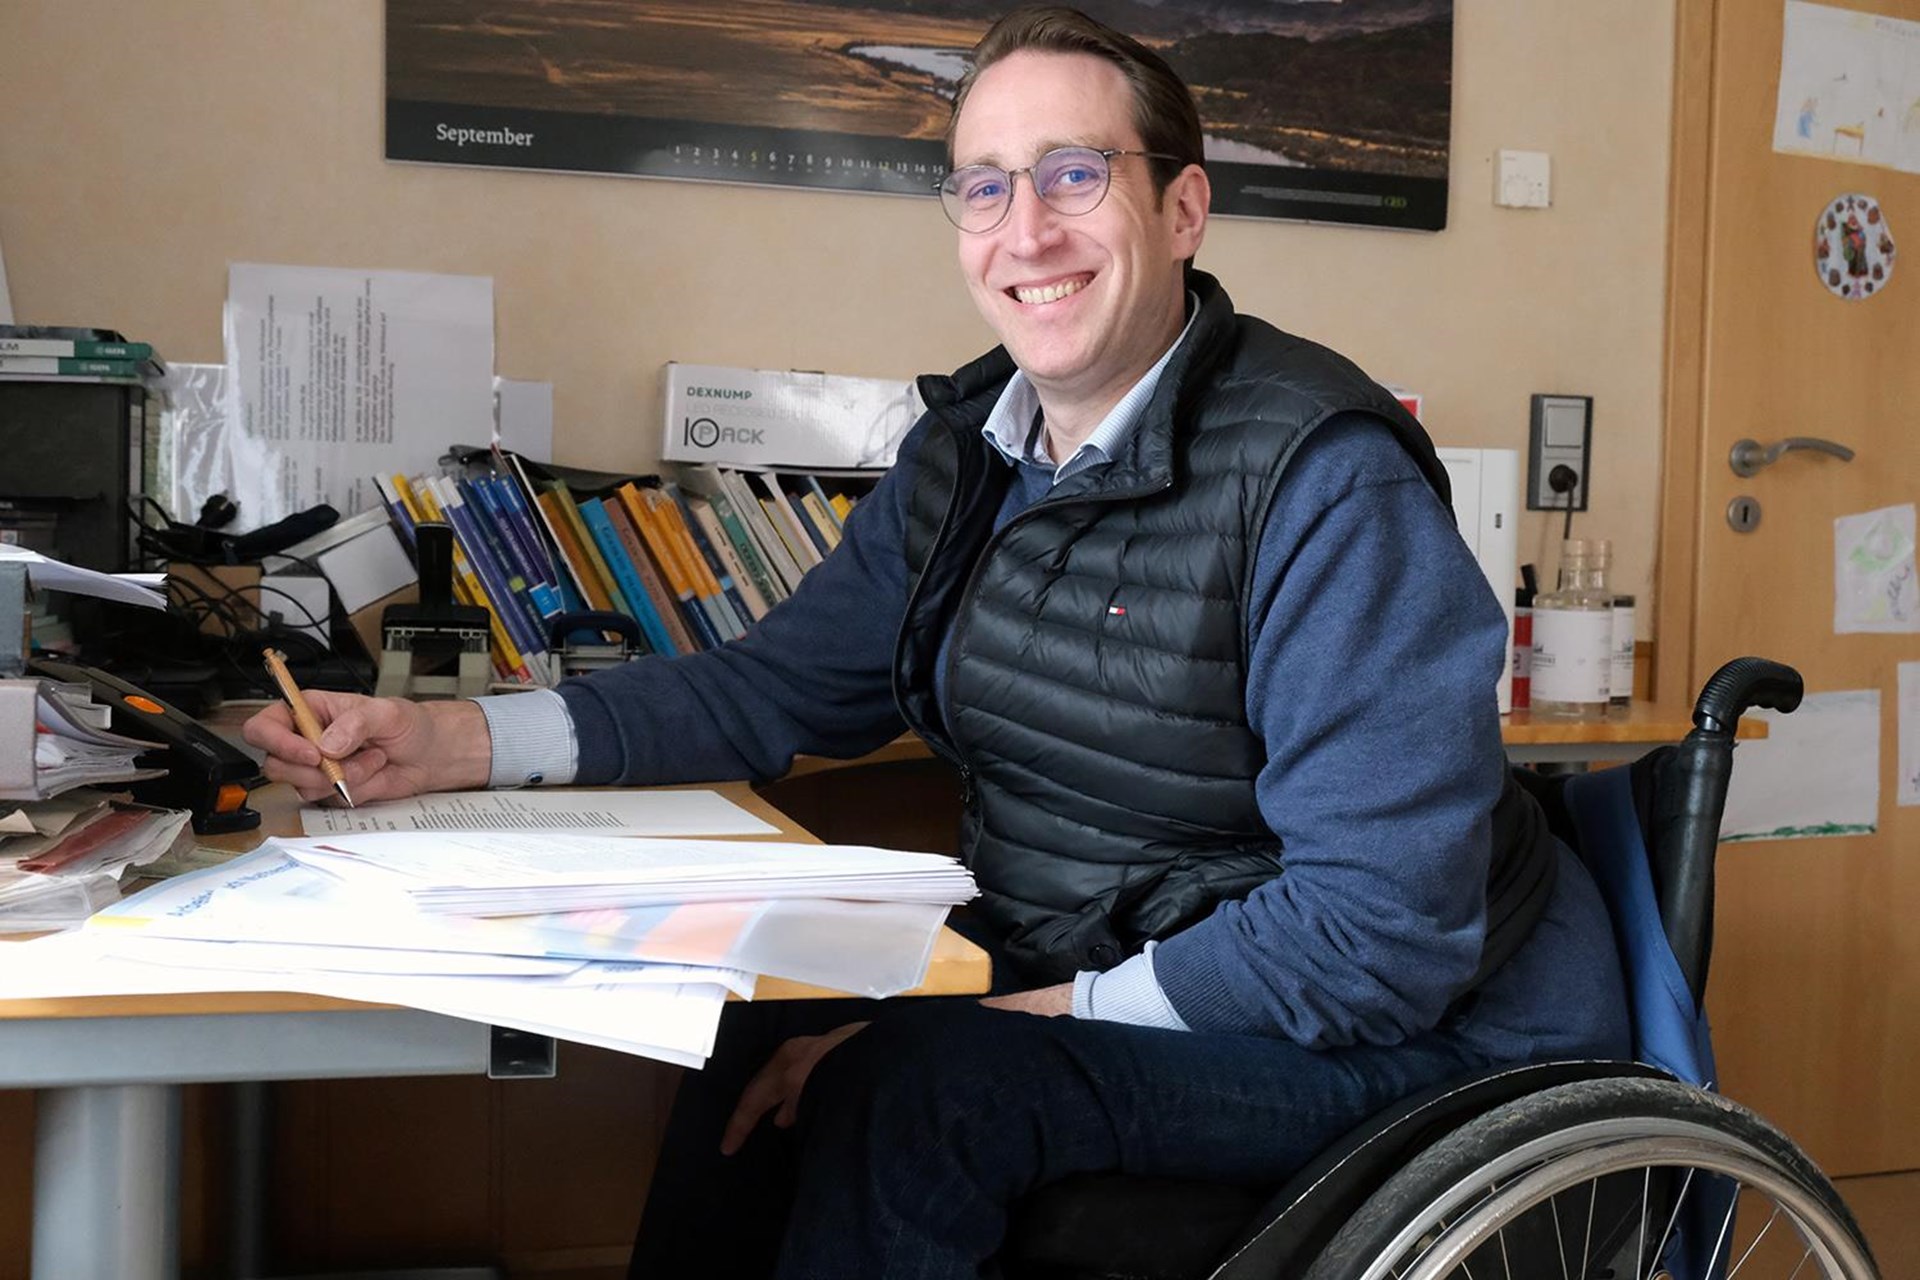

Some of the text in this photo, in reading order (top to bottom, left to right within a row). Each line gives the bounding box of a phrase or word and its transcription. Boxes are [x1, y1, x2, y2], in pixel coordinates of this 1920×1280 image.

[436, 123, 534, 146] September
[841, 158, 853, 167] 10
[860, 159, 870, 169] 11
[879, 161, 889, 171] 12
[897, 162, 908, 173] 13
[914, 164, 926, 174] 14
[932, 164, 944, 176] 15
[686, 386, 752, 400] DEXNUMP
